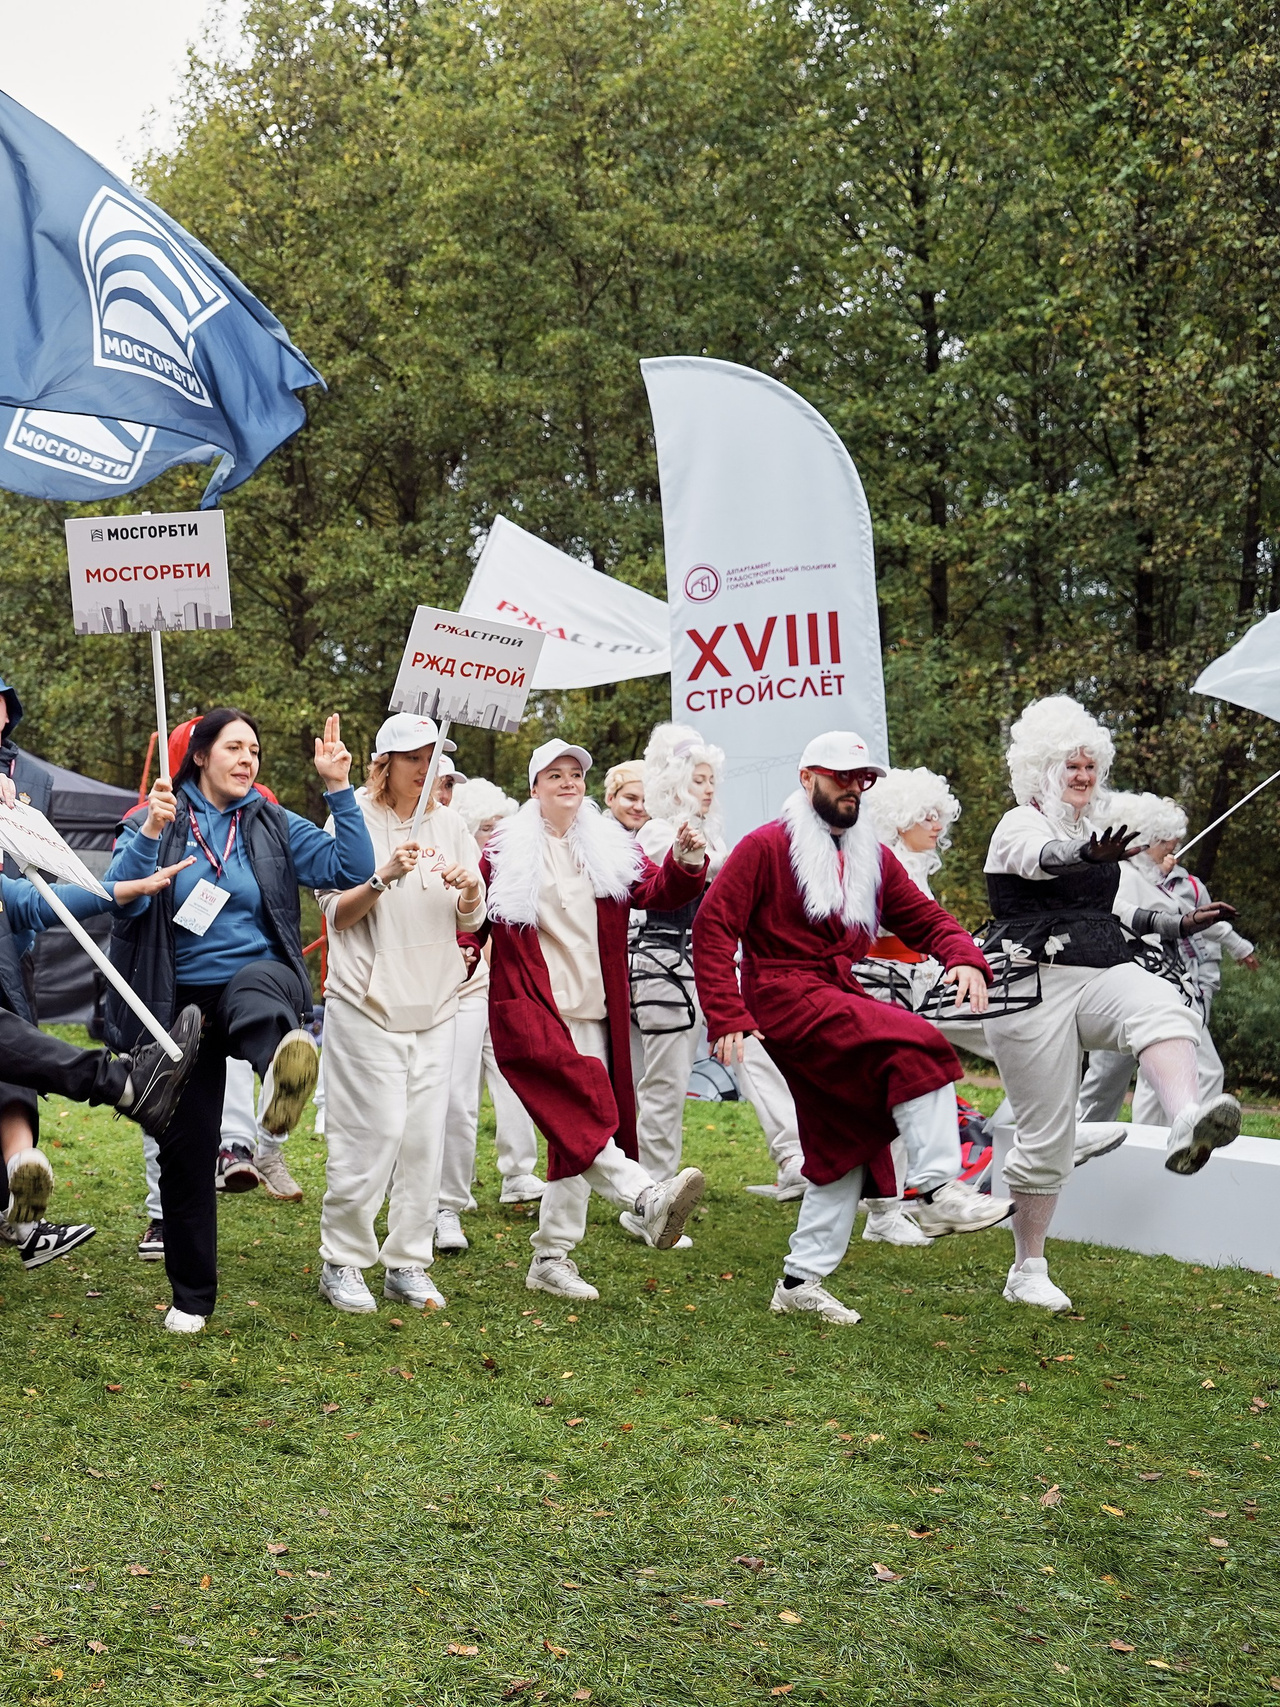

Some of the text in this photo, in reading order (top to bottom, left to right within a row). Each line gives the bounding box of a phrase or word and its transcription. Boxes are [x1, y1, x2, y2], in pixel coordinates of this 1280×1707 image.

[103, 334, 200, 395] МОСГОРБТИ
[16, 426, 131, 480] МОСГОРБТИ
[107, 523, 198, 541] МОСГОРБТИ
[86, 562, 211, 584] МОСГОРБТИ
[726, 561, 771, 576] ДЕПАРТАМЕНТ
[726, 563, 837, 583] ГРАДОСТРОИТЕЛЬНОЙ ПОЛИТИКИ
[726, 575, 786, 591] ГОРОДА МОСКВЫ
[686, 611, 841, 681] XVIII
[411, 651, 526, 688] РЖД СТРОЙ
[686, 670, 845, 712] СТРОЙСЛЁТ
